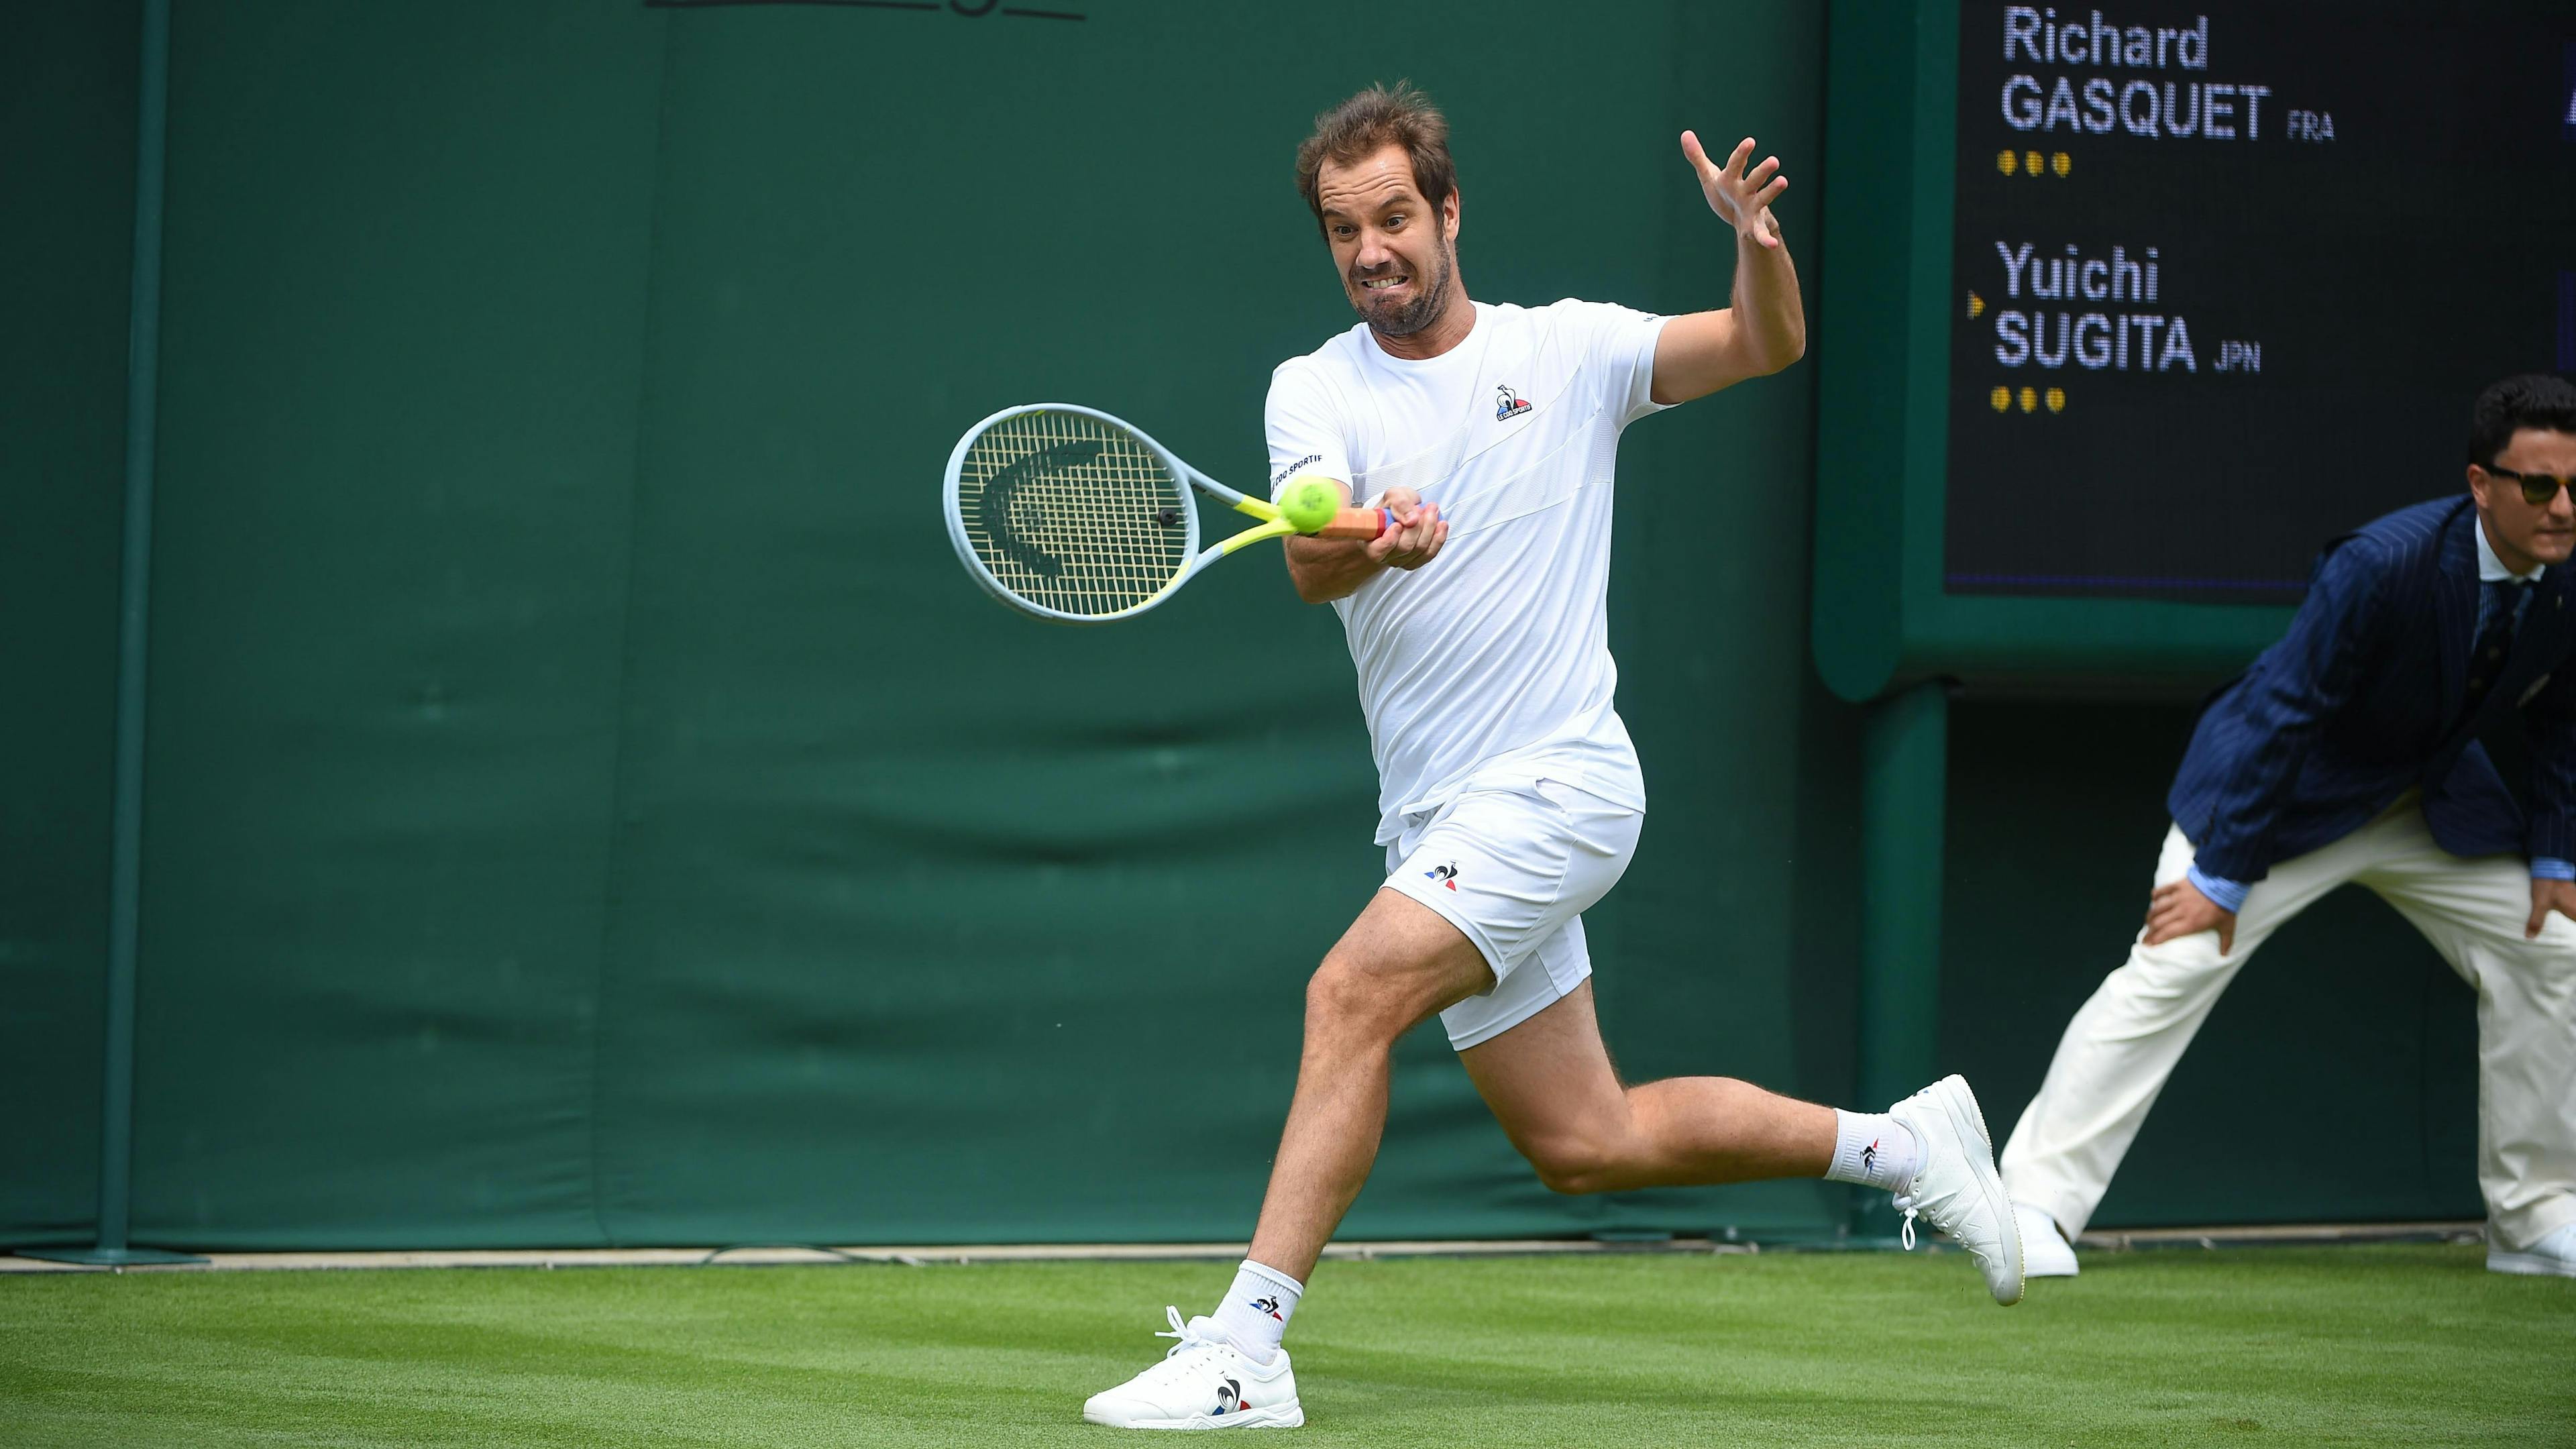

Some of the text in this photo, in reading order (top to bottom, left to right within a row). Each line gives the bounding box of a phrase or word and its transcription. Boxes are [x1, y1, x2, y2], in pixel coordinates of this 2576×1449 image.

[2003, 5, 2208, 70] Richard
[2001, 74, 2334, 142] GASQUET FRA
[1996, 241, 2159, 303] Yuichi
[1994, 311, 2261, 373] SUGITA JPN
[1513, 404, 1532, 415] SPORTIF
[1289, 454, 1323, 475] SPORTIF
